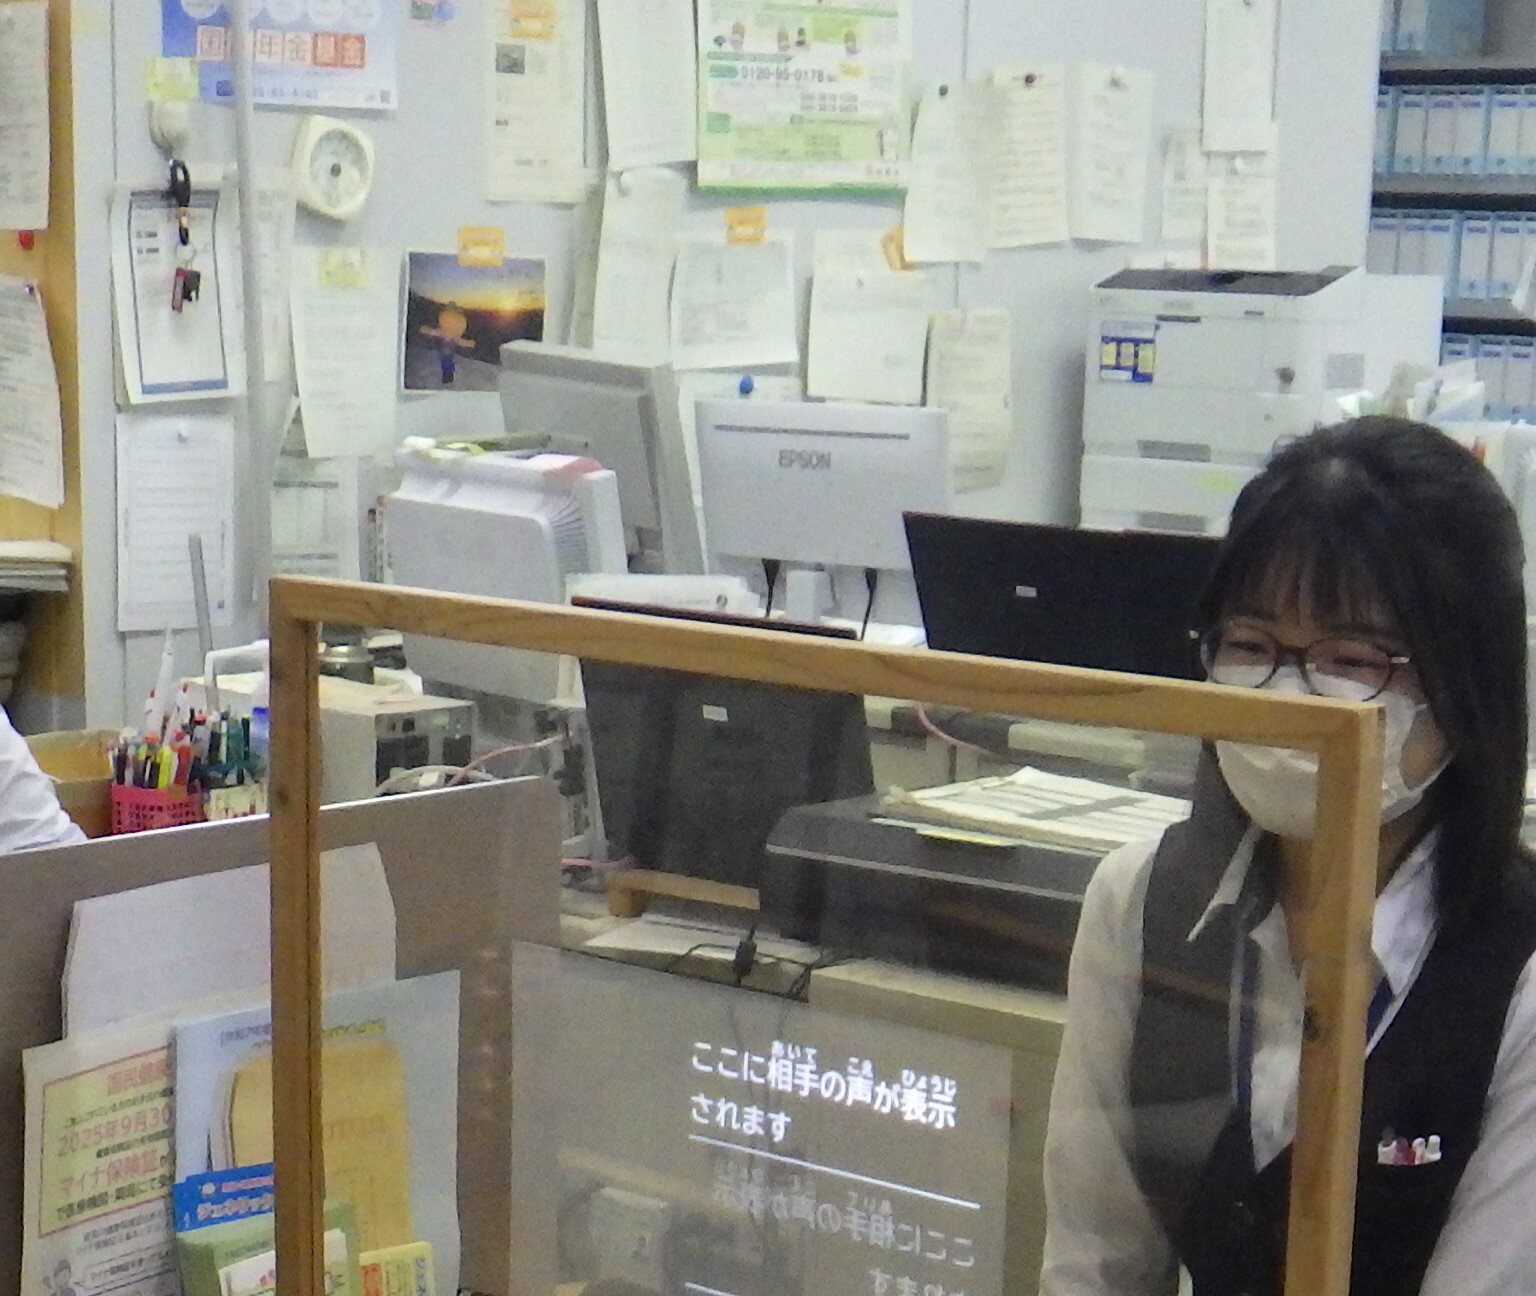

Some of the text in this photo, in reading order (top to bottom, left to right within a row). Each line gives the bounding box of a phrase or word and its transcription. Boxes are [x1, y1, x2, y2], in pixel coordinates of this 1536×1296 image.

[778, 449, 832, 470] EPSON
[692, 1042, 957, 1129] ここに相手の声が表示
[690, 1093, 792, 1143] されます
